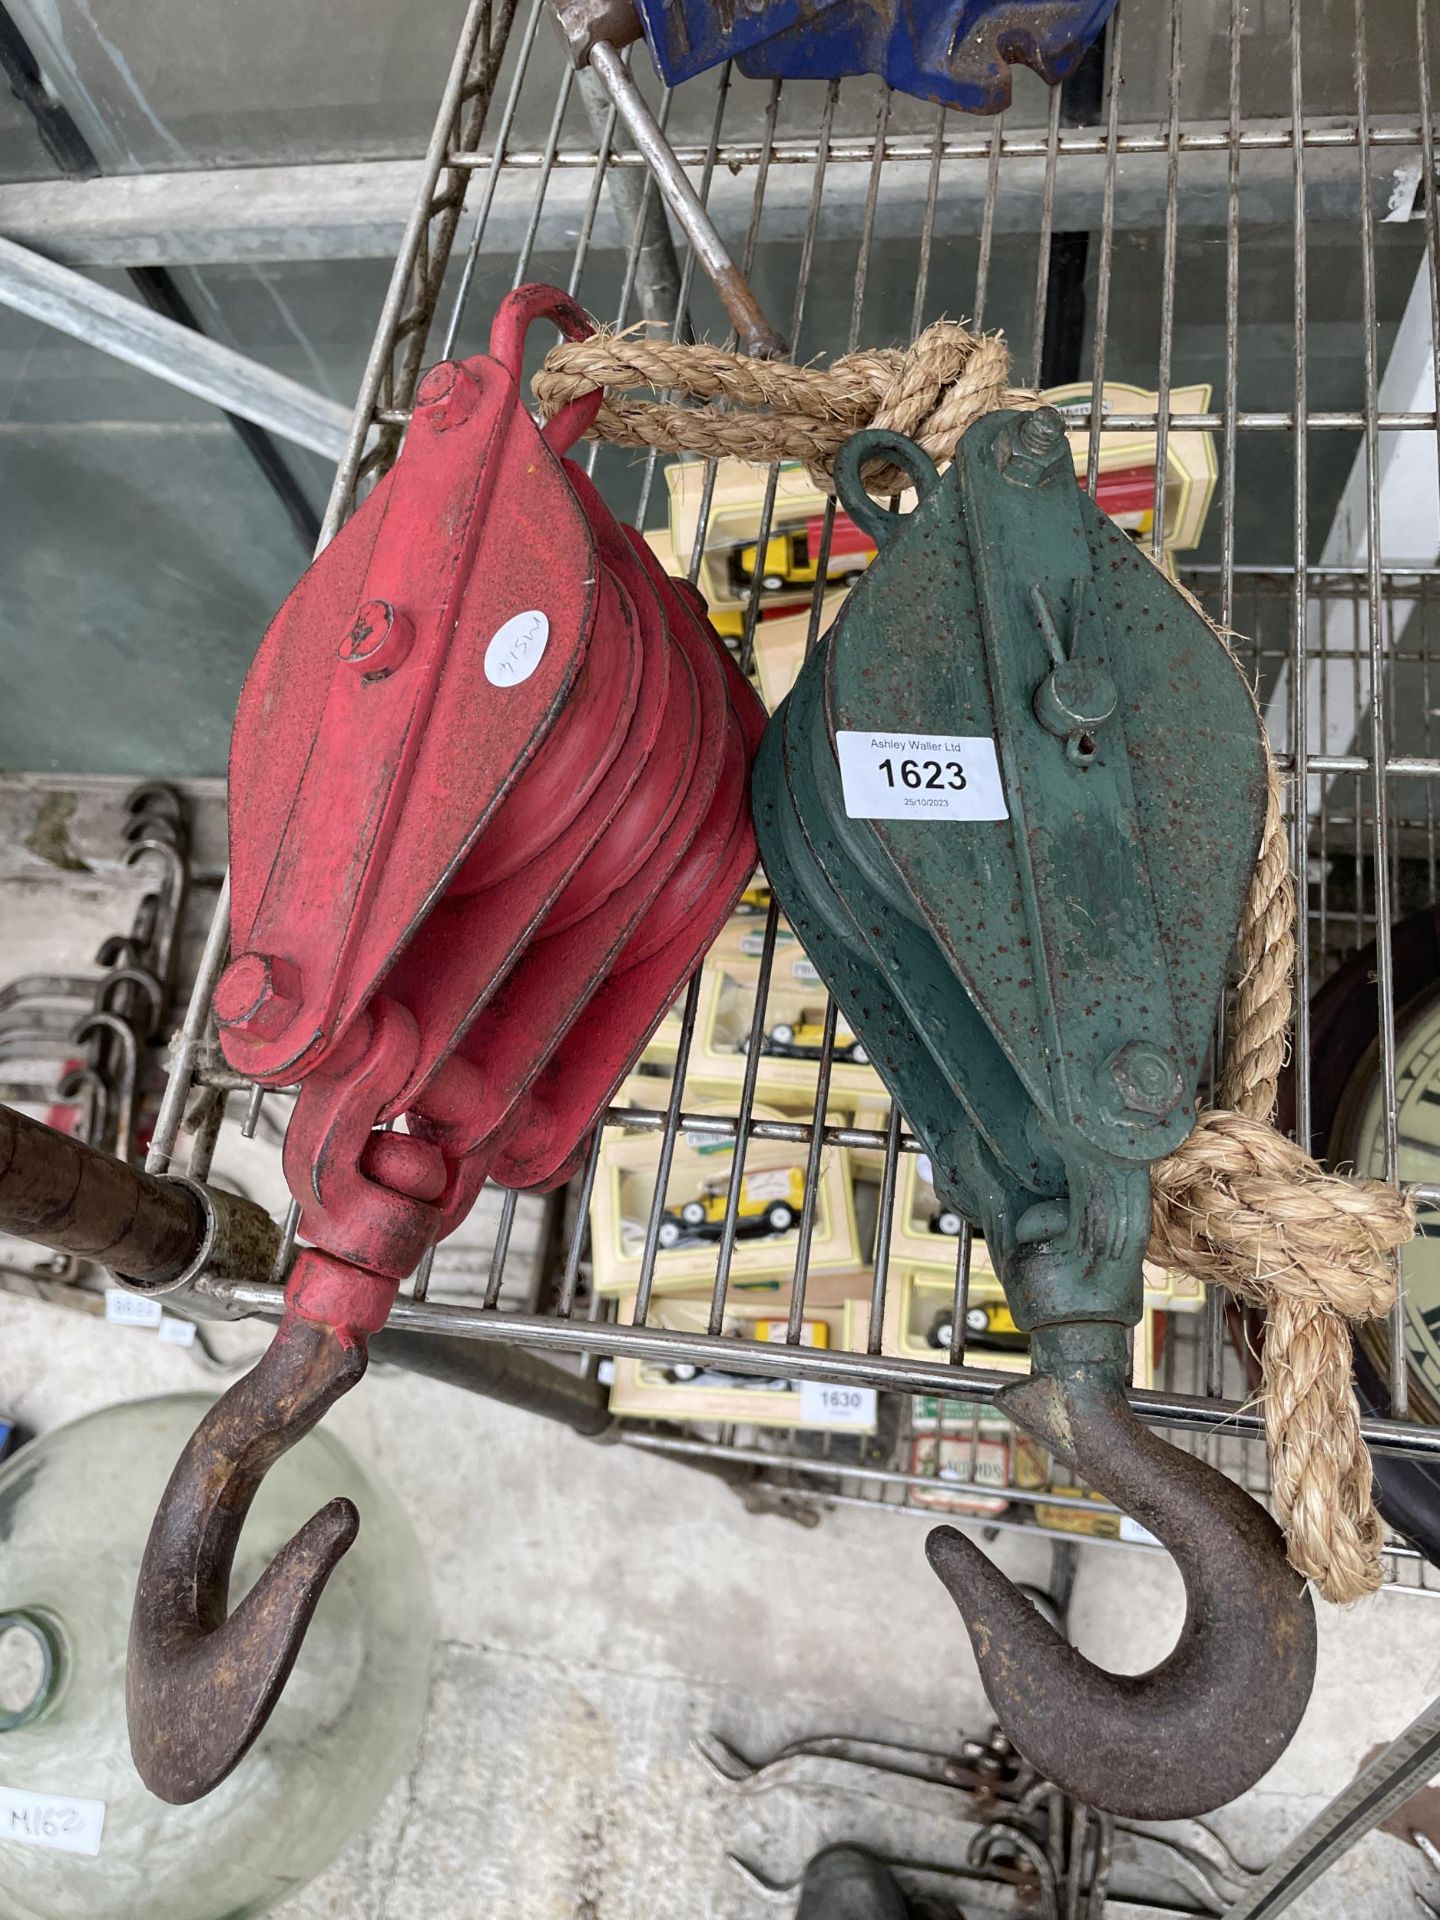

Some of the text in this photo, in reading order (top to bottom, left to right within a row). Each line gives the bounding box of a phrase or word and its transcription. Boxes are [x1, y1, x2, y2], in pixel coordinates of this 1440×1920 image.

[871, 739, 961, 752] Ashley Waller Ltd
[879, 759, 967, 790] 1623
[904, 798, 949, 807] 25/10/2023
[821, 1391, 861, 1407] 1630
[9, 1806, 86, 1838] M162
